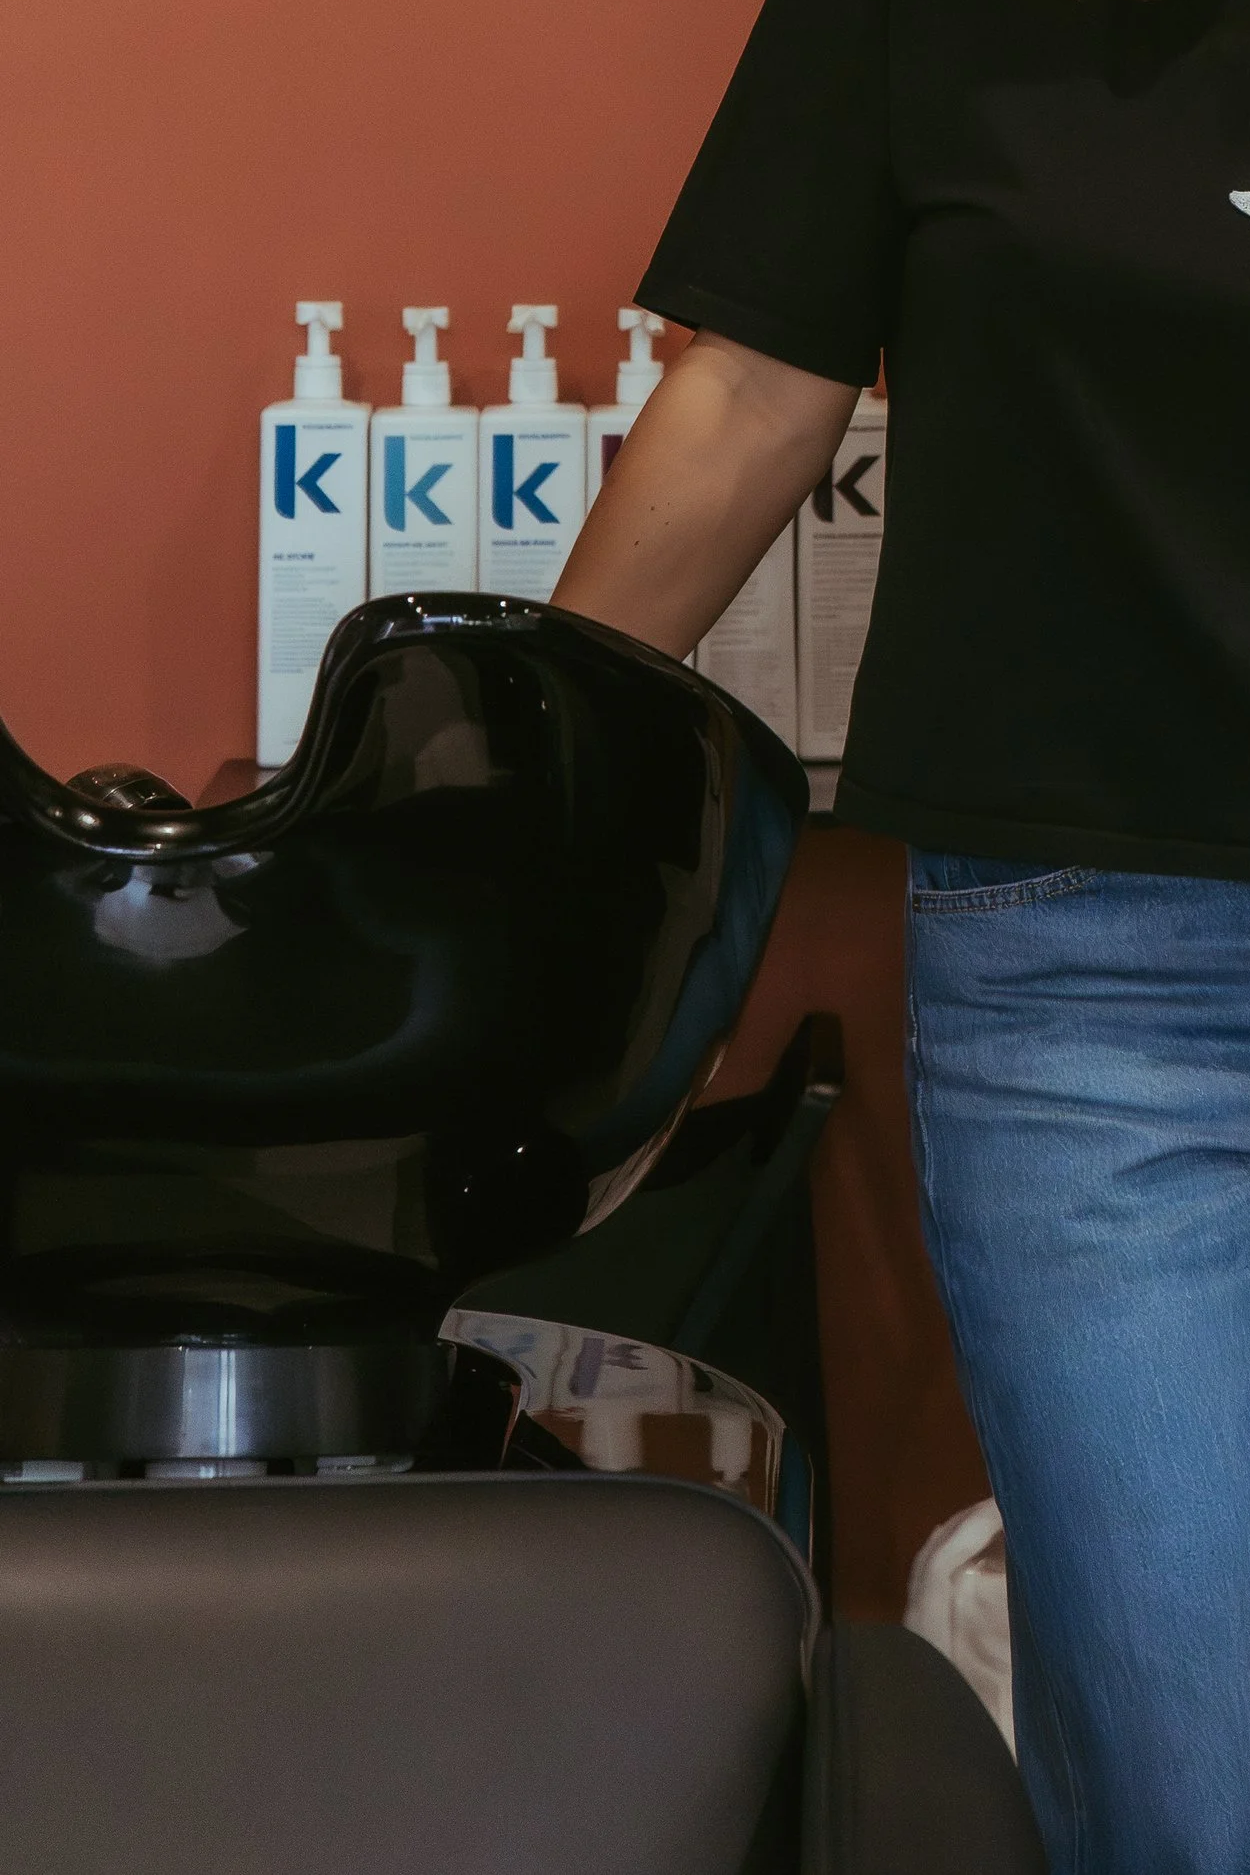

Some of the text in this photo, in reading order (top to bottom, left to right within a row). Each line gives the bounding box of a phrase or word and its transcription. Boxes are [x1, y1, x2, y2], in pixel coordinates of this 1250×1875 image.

[274, 423, 344, 520] k
[383, 434, 455, 533] k
[491, 433, 561, 531] k
